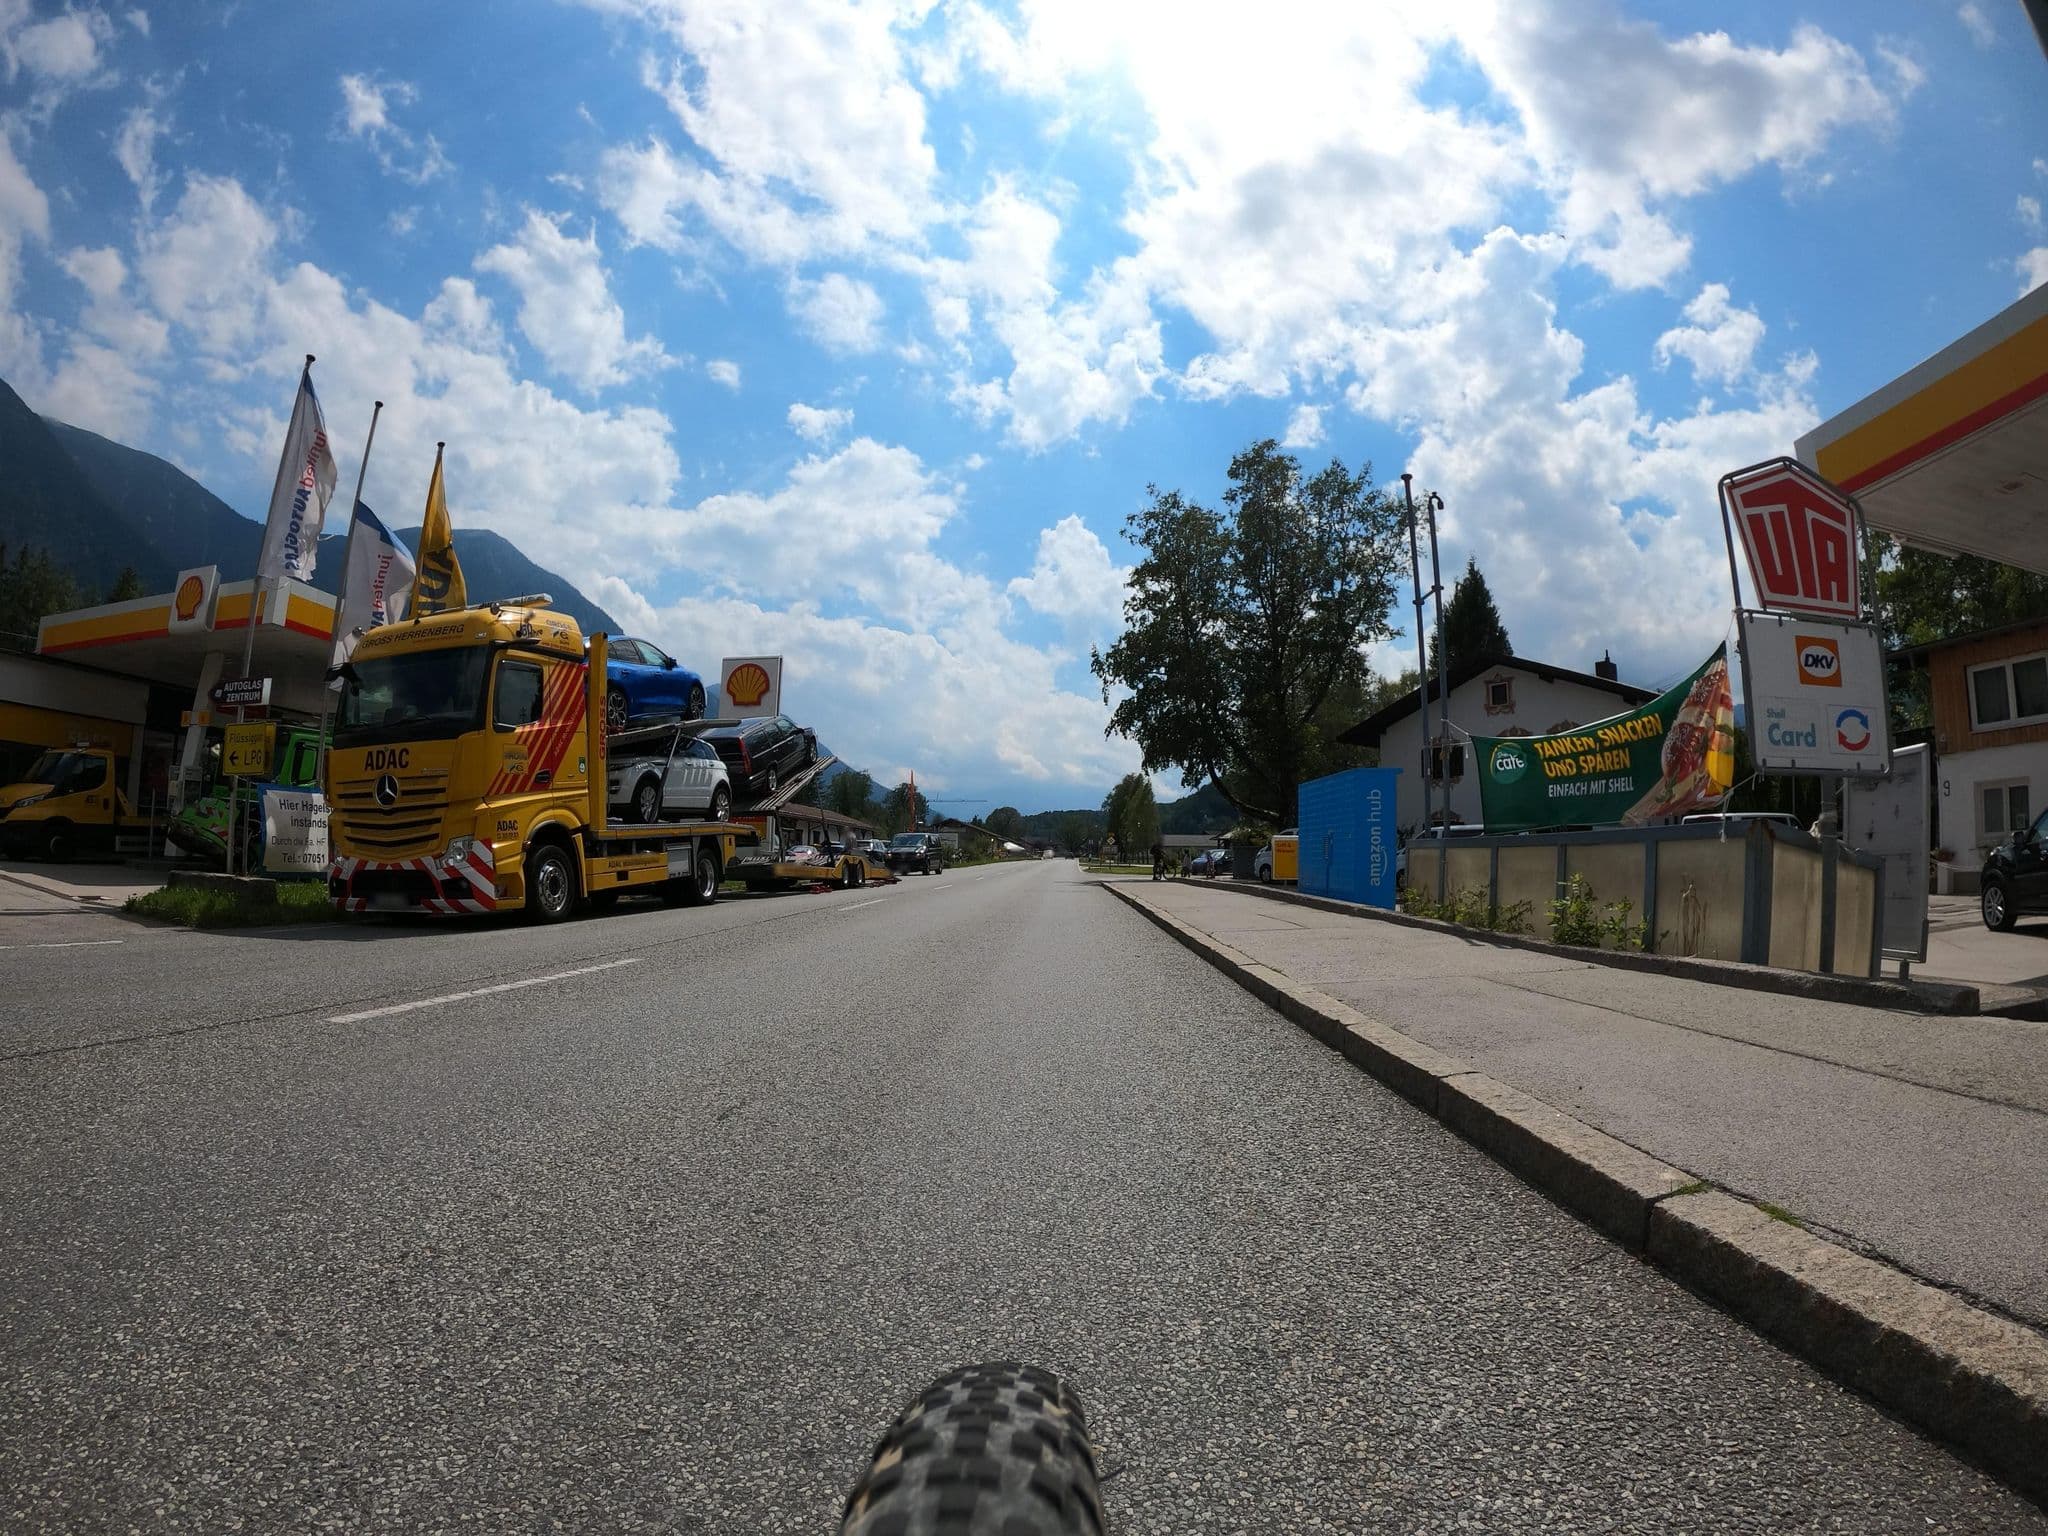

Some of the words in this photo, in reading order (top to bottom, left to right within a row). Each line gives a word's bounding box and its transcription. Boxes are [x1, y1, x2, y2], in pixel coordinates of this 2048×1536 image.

[1738, 477, 1851, 604] UTA
[361, 634, 394, 649] GROSS
[395, 624, 465, 643] HERRENBERG
[1804, 653, 1835, 670] DKV
[224, 680, 263, 692] AUTOGLAS
[226, 691, 261, 703] ZENTRUM
[1766, 708, 1786, 719] Shell
[599, 695, 607, 760] GROSS
[1534, 736, 1600, 760] TANKEN,
[1597, 712, 1664, 748] SNACKEN
[1767, 722, 1817, 748] Card
[244, 748, 263, 766] LPG
[364, 748, 410, 771] ADAC
[1544, 758, 1577, 778] UND
[1579, 748, 1631, 774] SPAREN
[1548, 781, 1587, 798] EINFACH
[1589, 780, 1607, 795] MIT
[1608, 776, 1634, 793] SHELL
[1942, 780, 1951, 797] 9
[279, 799, 299, 811] Hier
[301, 800, 332, 815] Hagels
[1366, 788, 1382, 822] hub
[496, 819, 519, 832] ADAC
[302, 853, 326, 865] 07051
[1370, 826, 1382, 887] amazon
